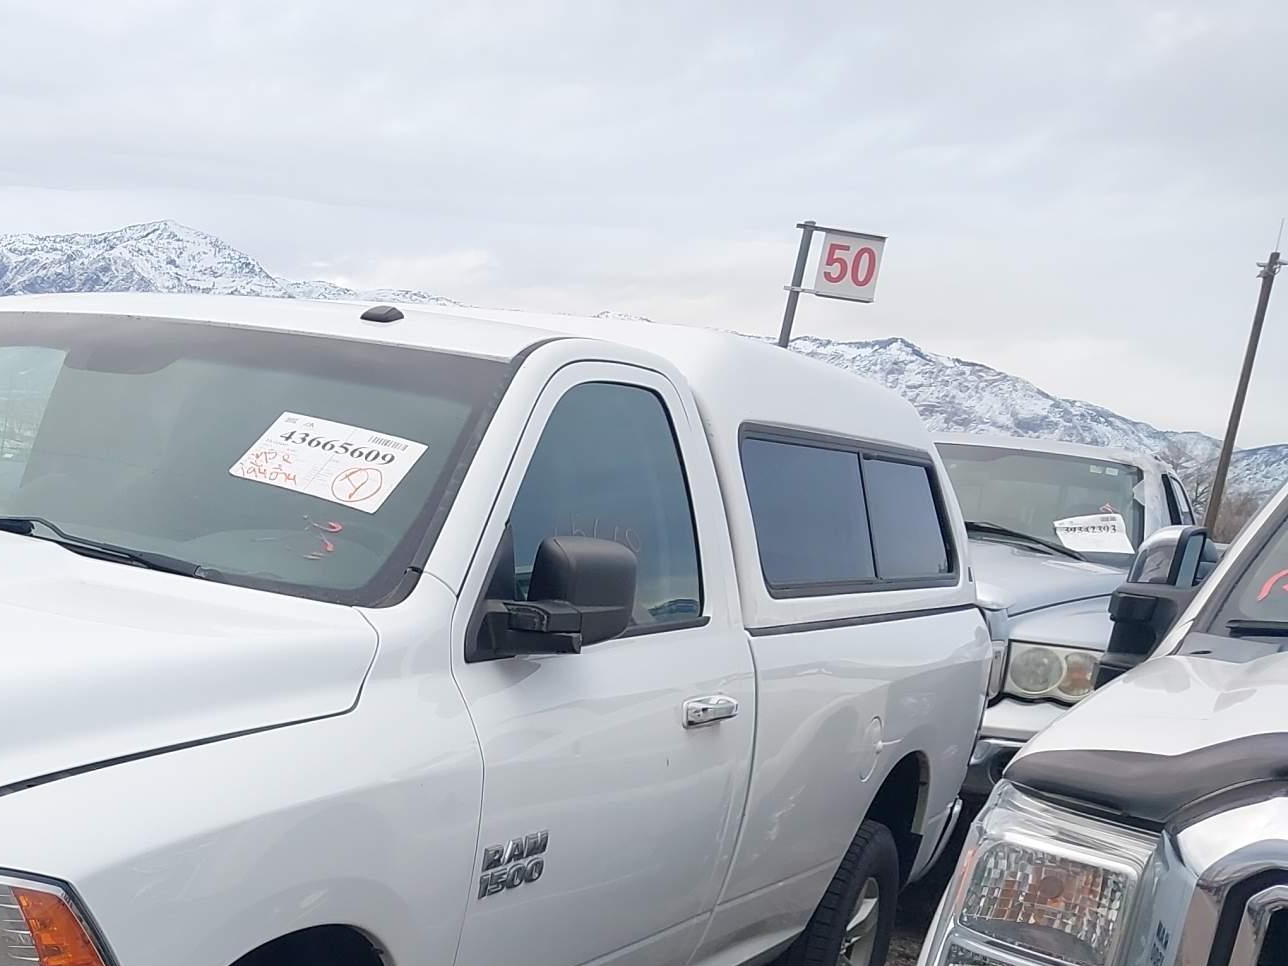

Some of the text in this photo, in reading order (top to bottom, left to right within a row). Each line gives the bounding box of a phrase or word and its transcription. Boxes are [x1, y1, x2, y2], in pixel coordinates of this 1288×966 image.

[823, 242, 877, 288] 50
[279, 428, 396, 467] 43665609
[481, 830, 549, 873] RAM
[477, 855, 544, 900] 1500
